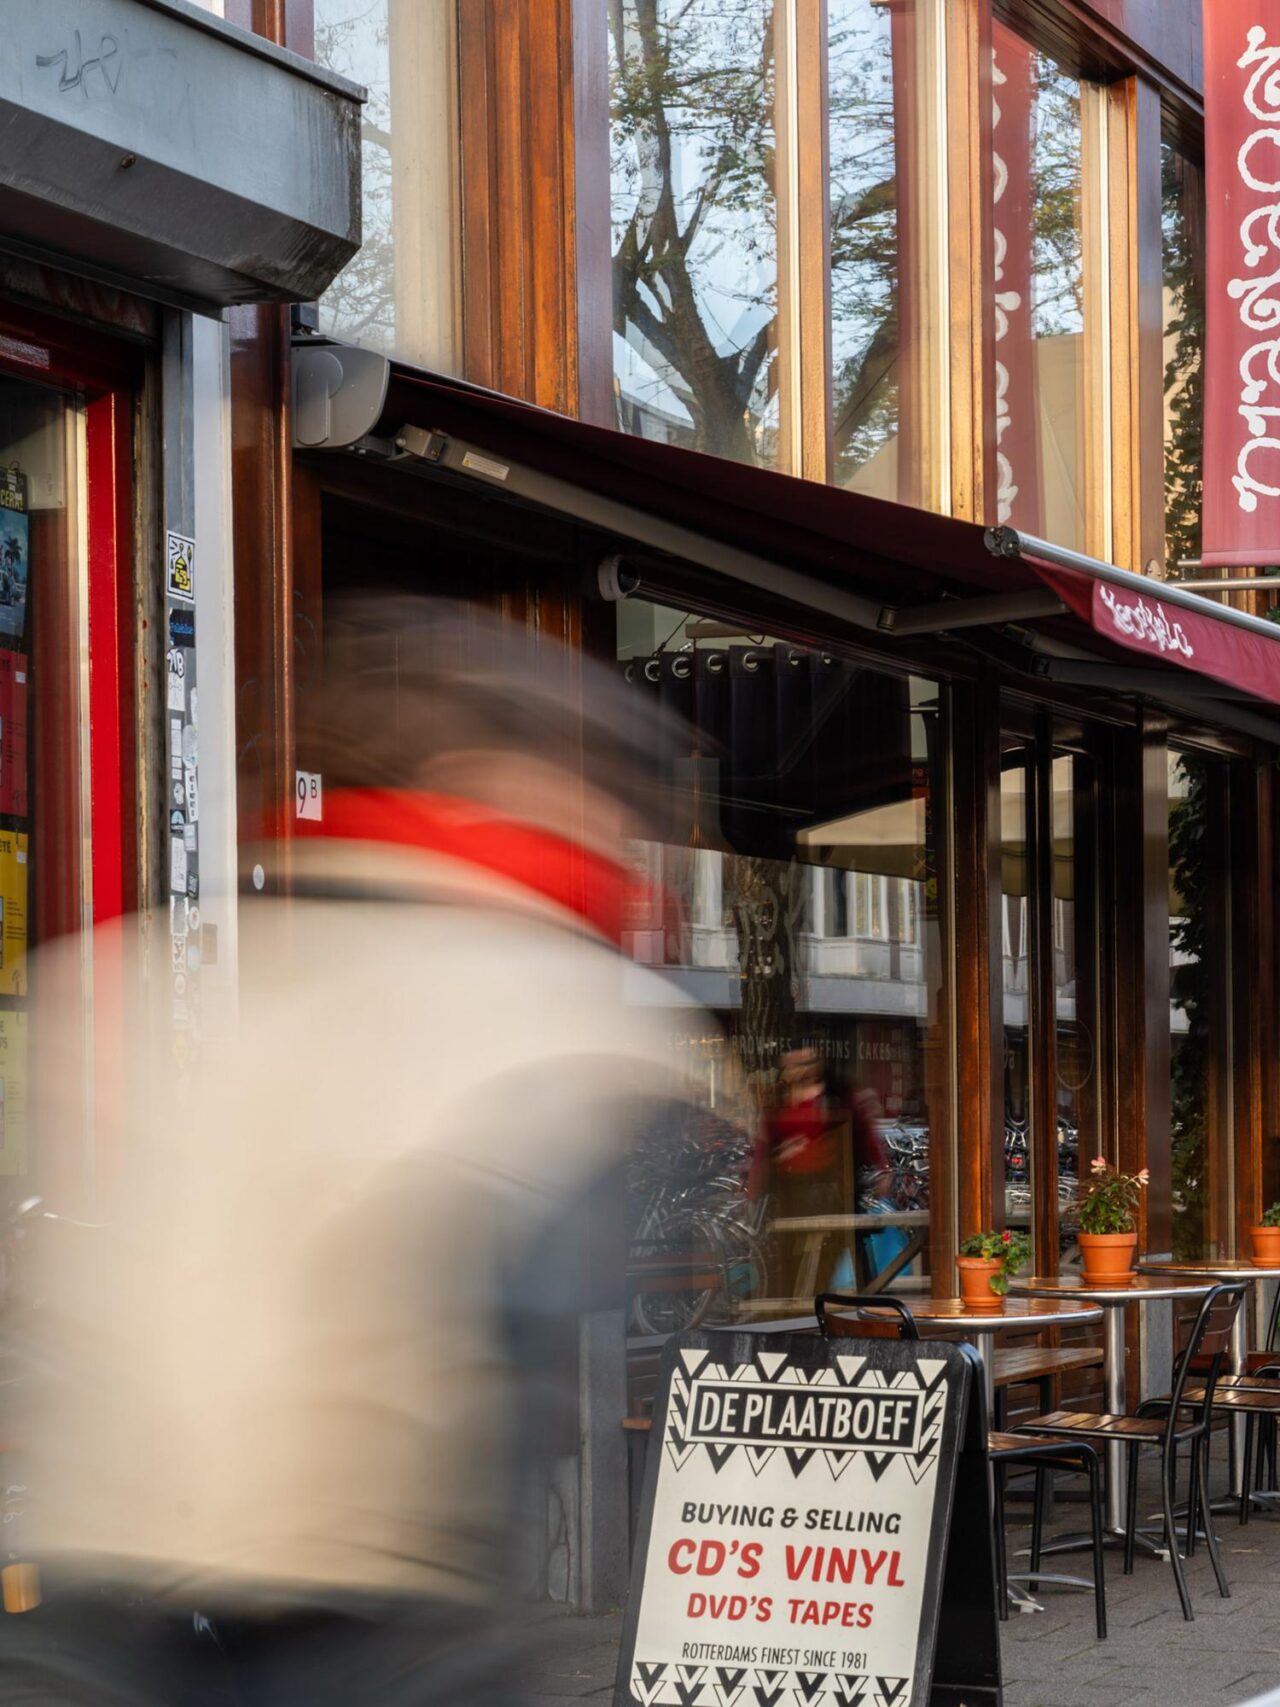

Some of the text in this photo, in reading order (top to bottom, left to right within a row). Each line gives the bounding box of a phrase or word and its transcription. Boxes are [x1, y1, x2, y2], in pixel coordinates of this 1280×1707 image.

[801, 1037, 850, 1060] MUFFINS
[858, 1040, 891, 1061] CAKES
[700, 1391, 912, 1441] DE PLAATBOEF
[681, 1502, 902, 1535] BUYING & SELLING
[667, 1538, 905, 1587] CD'S VINYL
[686, 1592, 874, 1628] DVD'S TAPES
[682, 1642, 867, 1669] ROTTERDAMS FINEST SINCE 1981
